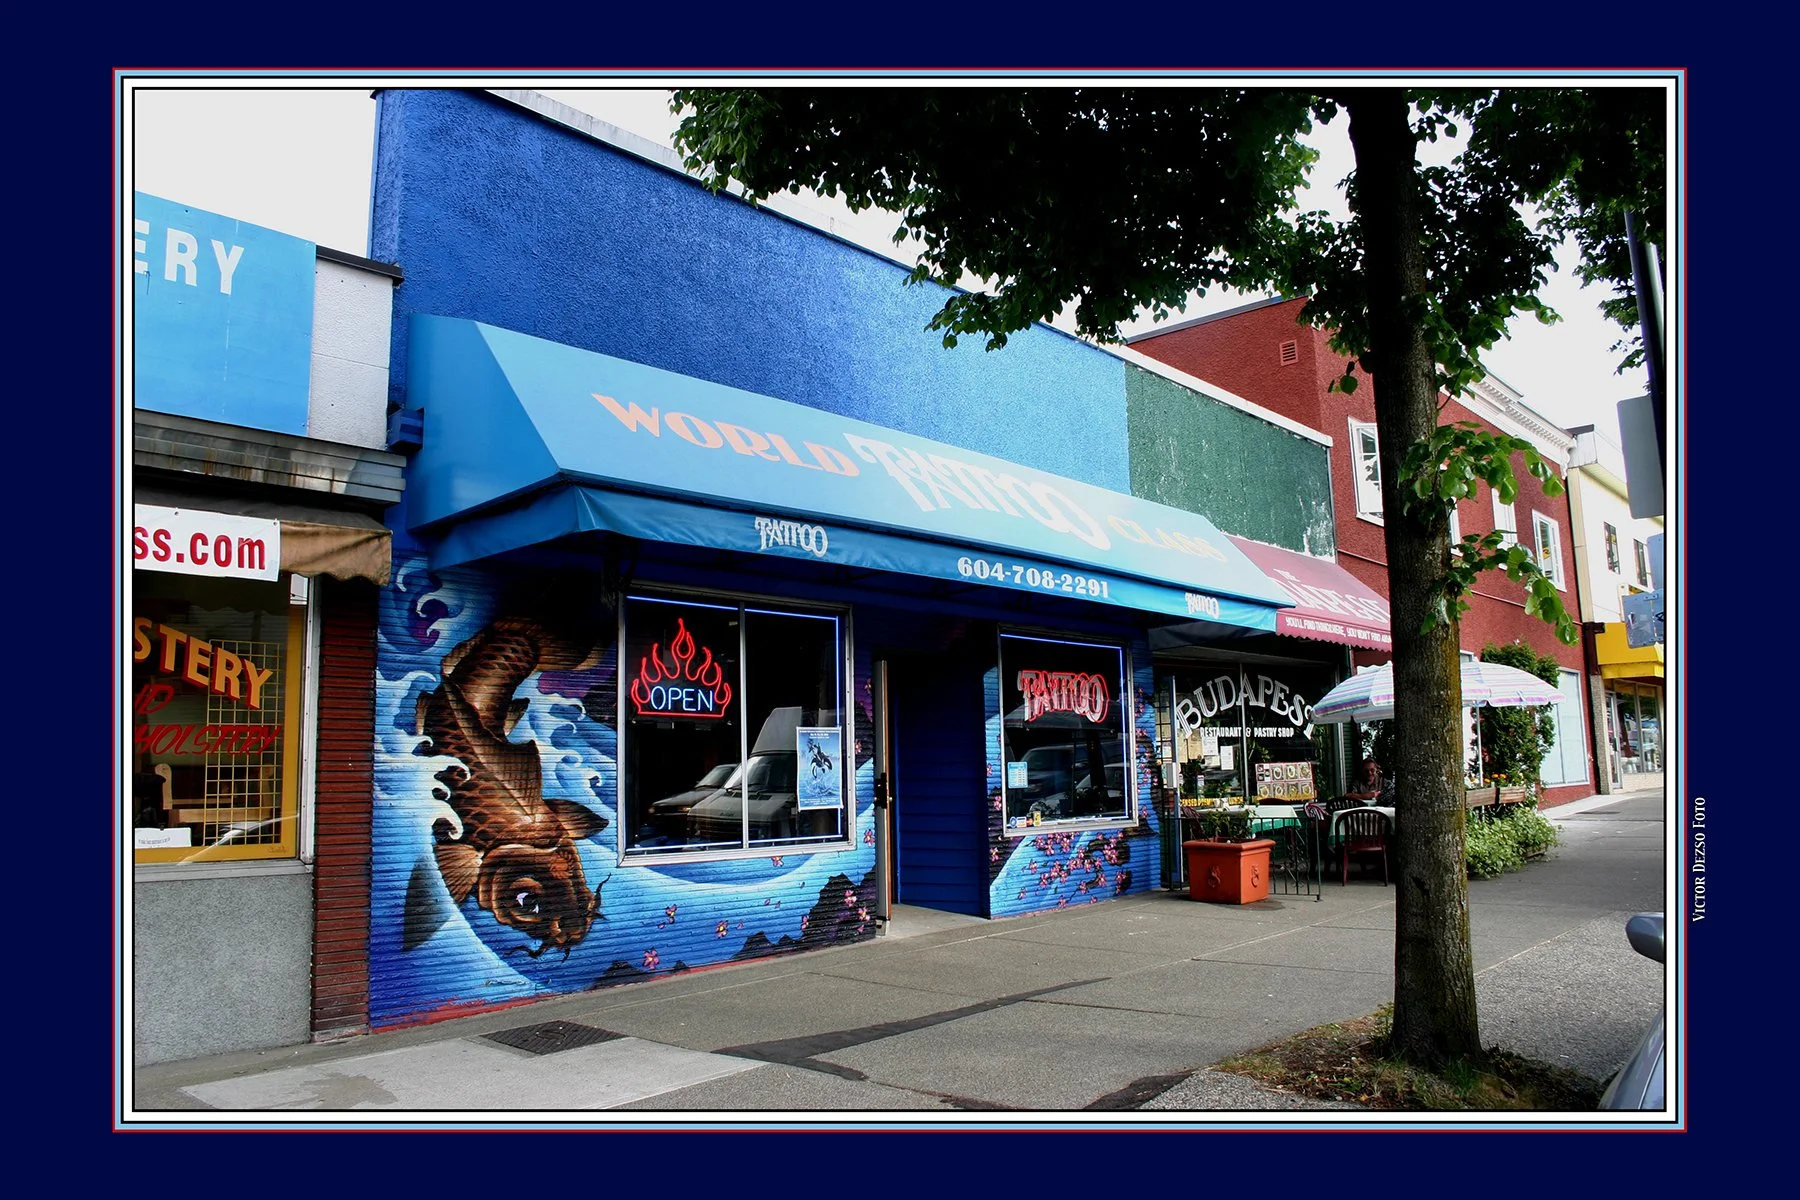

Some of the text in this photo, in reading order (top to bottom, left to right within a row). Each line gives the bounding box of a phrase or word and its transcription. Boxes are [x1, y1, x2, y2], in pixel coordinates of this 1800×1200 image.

[592, 393, 1229, 562] WORLD TATTOO CLASS
[754, 516, 829, 557] TATTOO
[957, 556, 1109, 598] 604-708-2291
[1185, 592, 1219, 619] TATTOO
[650, 685, 713, 711] OPEN
[1017, 669, 1110, 723] TATTOO
[1200, 726, 1295, 738] RESTAURANT & PASTRY SHOP
